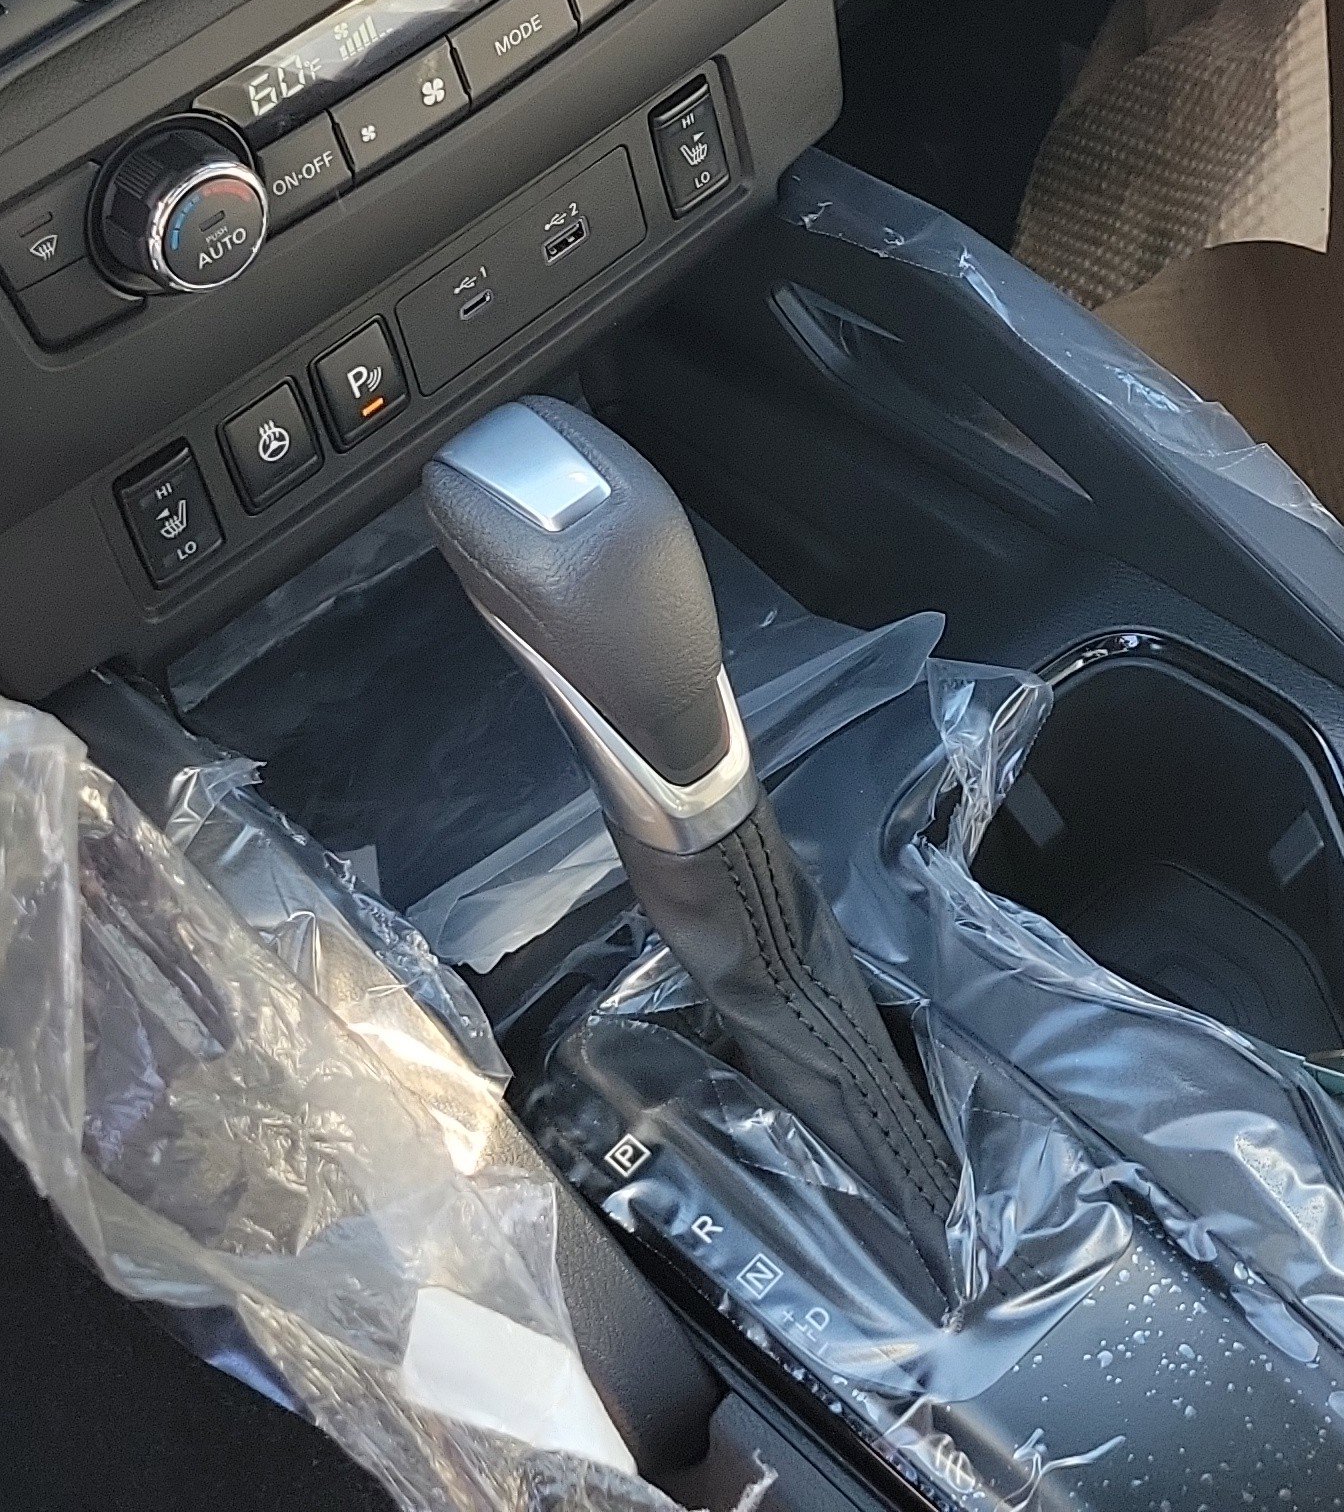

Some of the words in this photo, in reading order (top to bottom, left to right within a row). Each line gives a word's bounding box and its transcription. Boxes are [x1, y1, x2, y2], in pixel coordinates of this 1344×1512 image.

[494, 14, 543, 57] MODE
[681, 112, 696, 129] HI
[694, 171, 711, 189] LO
[569, 202, 579, 217] 2
[199, 228, 246, 270] AUTO
[480, 266, 488, 279] 1
[155, 482, 173, 500] HI
[176, 541, 198, 561] LO
[616, 1143, 635, 1168] P
[691, 1214, 724, 1244] R
[745, 1261, 775, 1290] N
[804, 1306, 831, 1331] D
